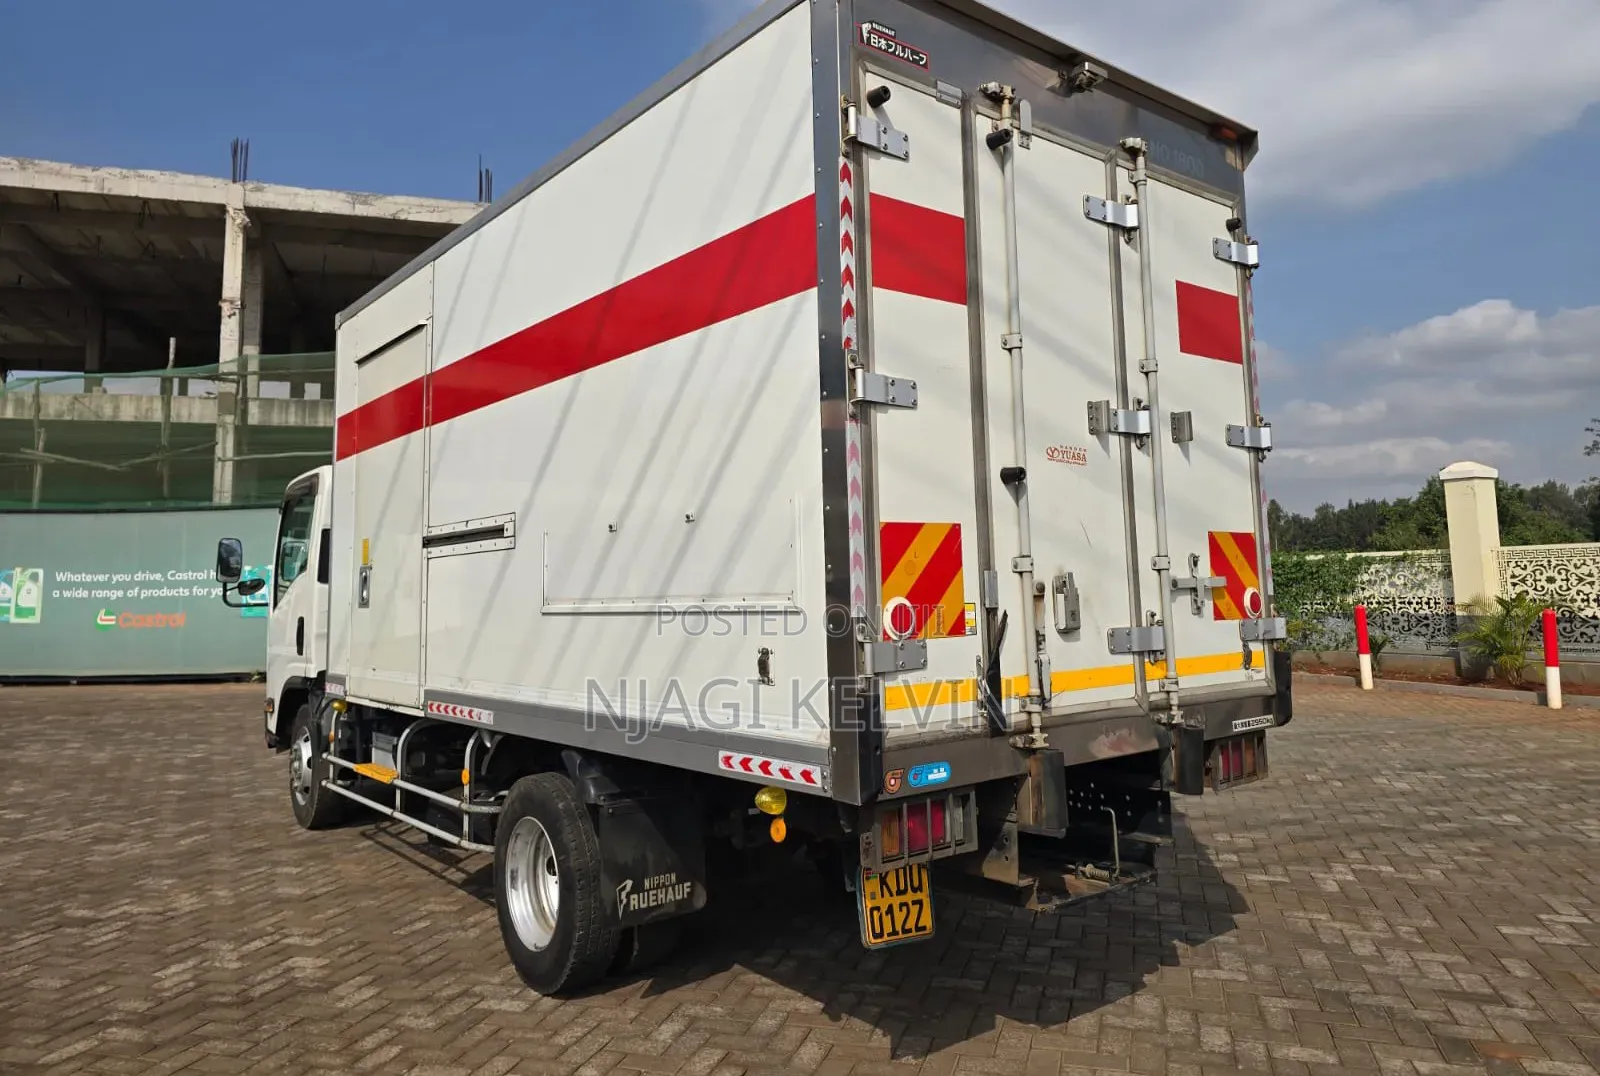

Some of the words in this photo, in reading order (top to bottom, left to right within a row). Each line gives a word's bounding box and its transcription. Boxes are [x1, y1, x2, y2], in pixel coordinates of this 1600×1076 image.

[1060, 450, 1087, 462] YUASA
[55, 571, 110, 582] Whatever
[111, 573, 132, 584] you
[133, 570, 165, 582] drive,
[167, 569, 208, 580] Castrol
[52, 590, 60, 598] a
[62, 587, 89, 598] wide
[91, 590, 124, 600] range
[127, 586, 140, 598] of
[140, 586, 190, 600] products
[192, 585, 209, 596] for
[210, 587, 230, 598] yo
[118, 610, 187, 629] Castrol
[644, 872, 676, 890] NIPPON
